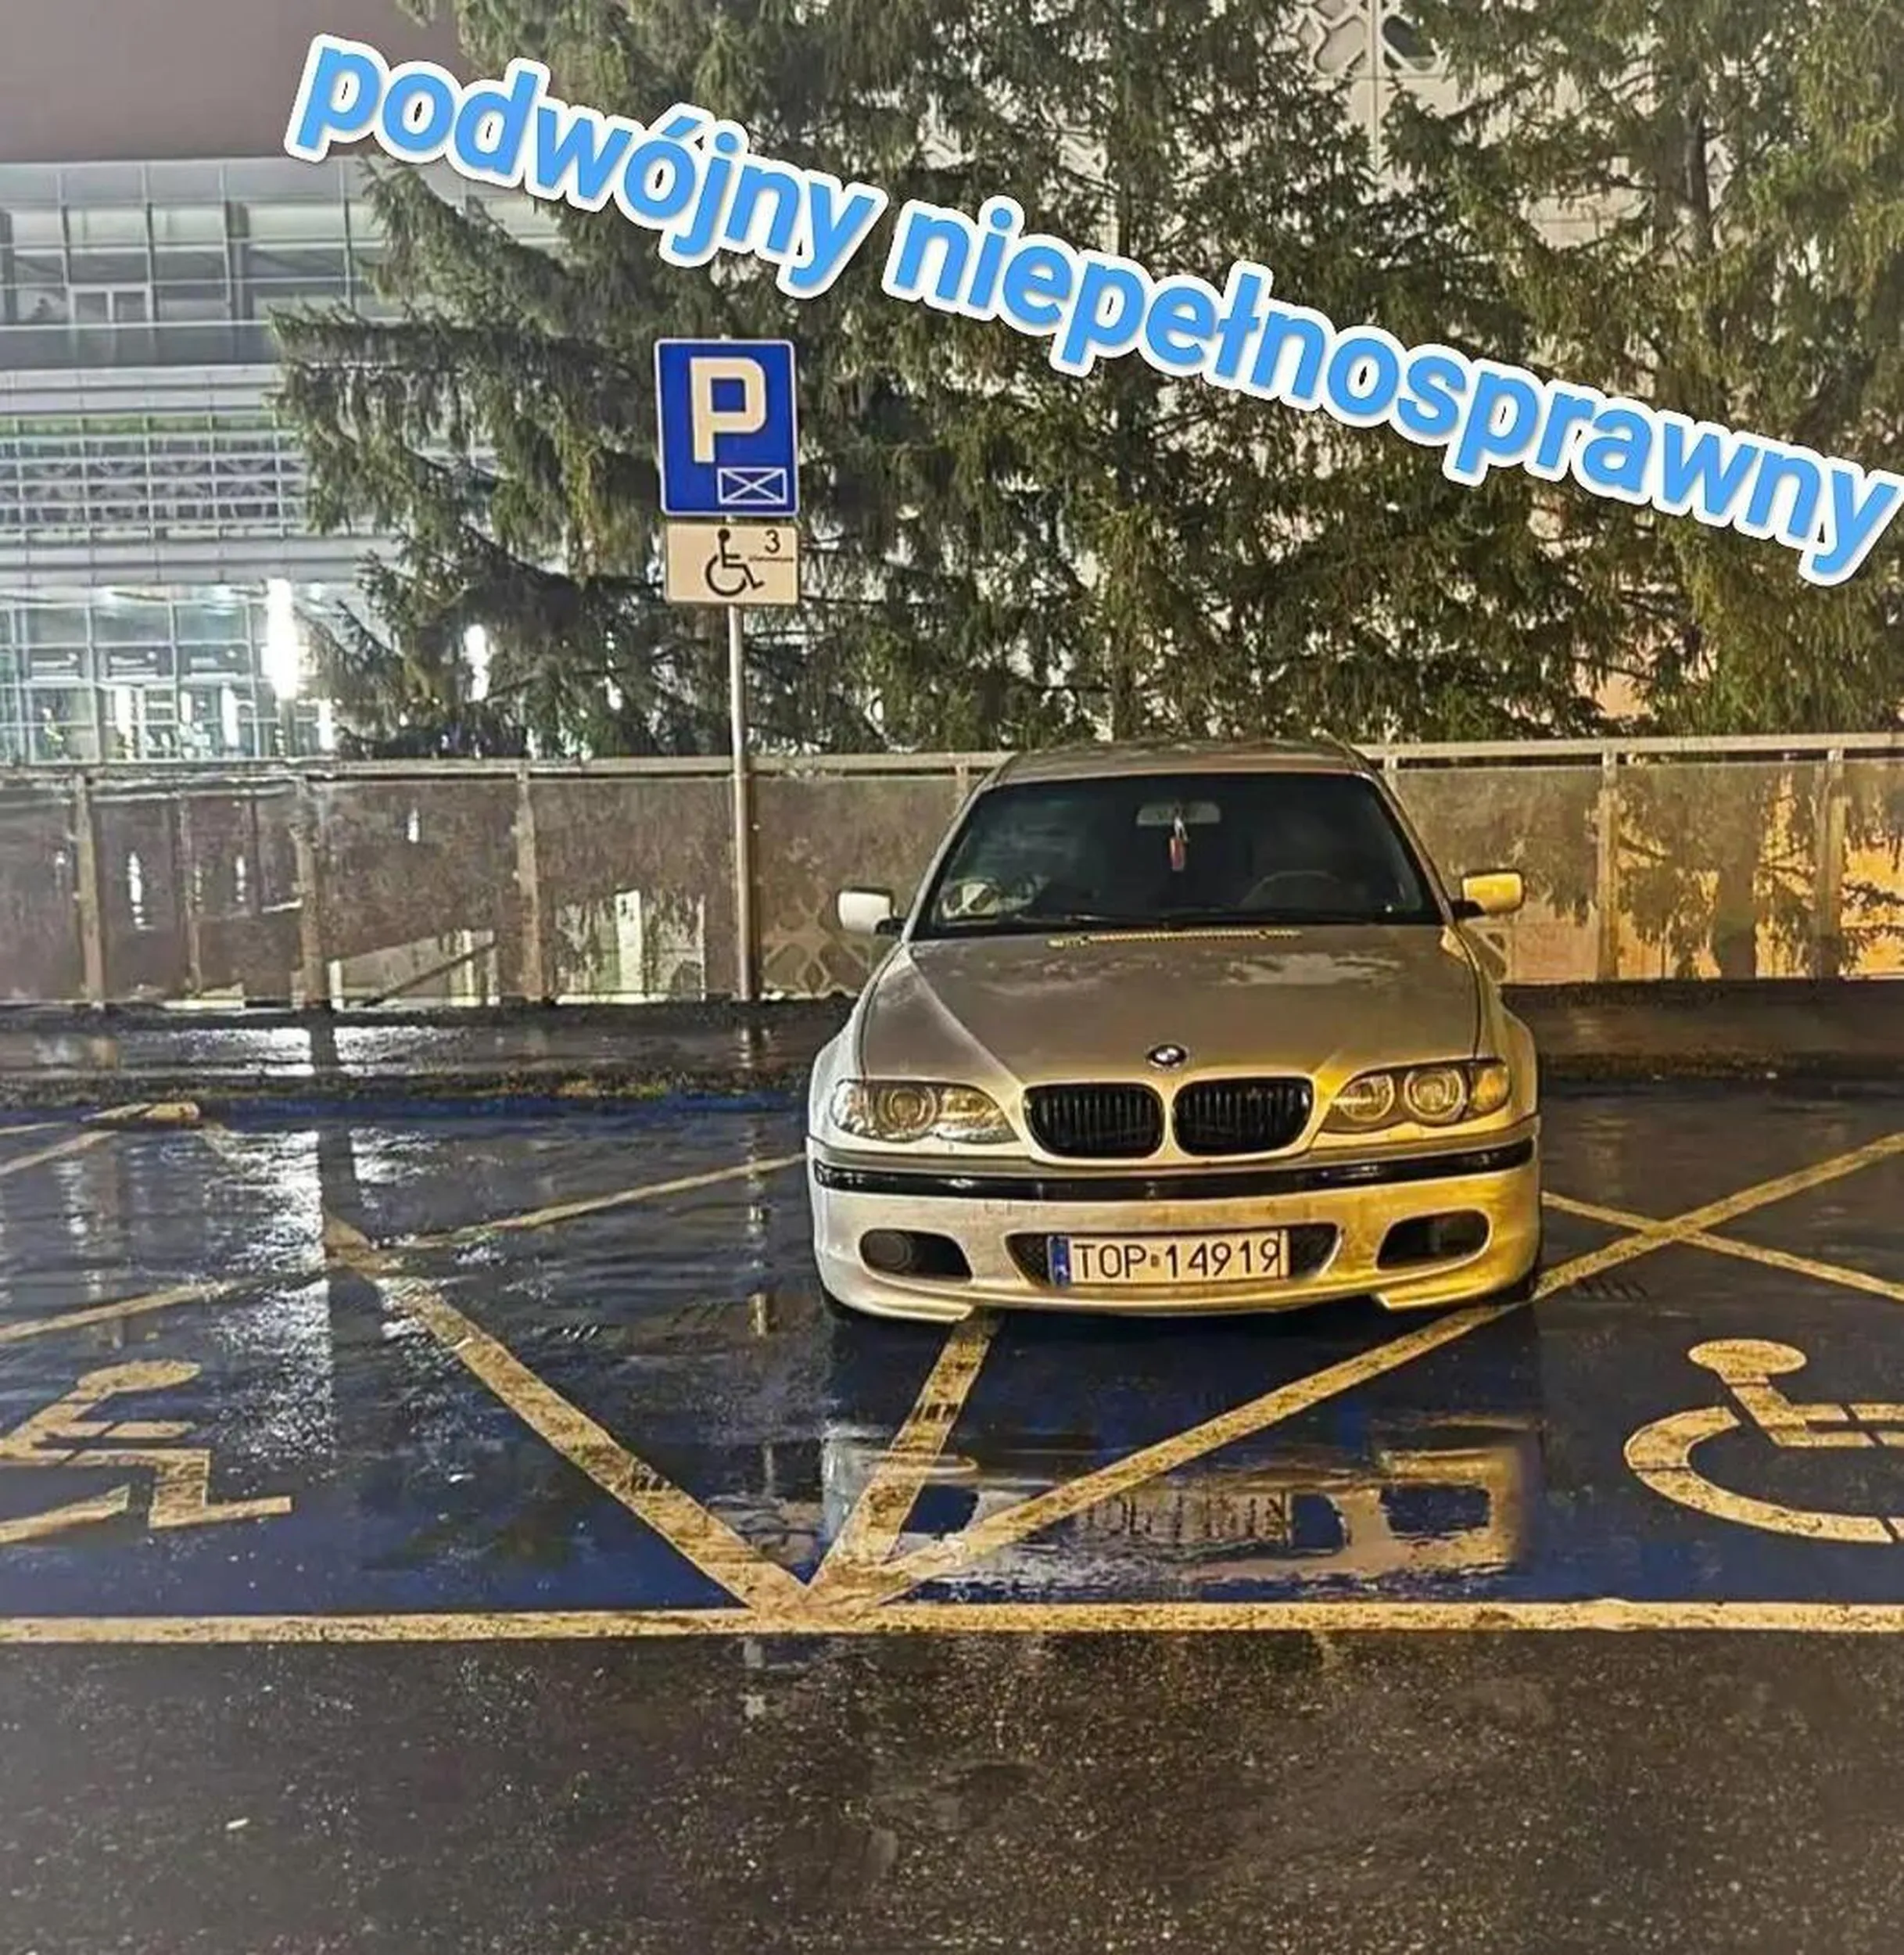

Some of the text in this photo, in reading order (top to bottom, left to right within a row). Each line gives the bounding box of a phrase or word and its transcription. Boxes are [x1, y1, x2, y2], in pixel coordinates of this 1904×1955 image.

[690, 357, 766, 463] P
[765, 529, 780, 554] 3
[1074, 1238, 1280, 1279] TOP 14919
